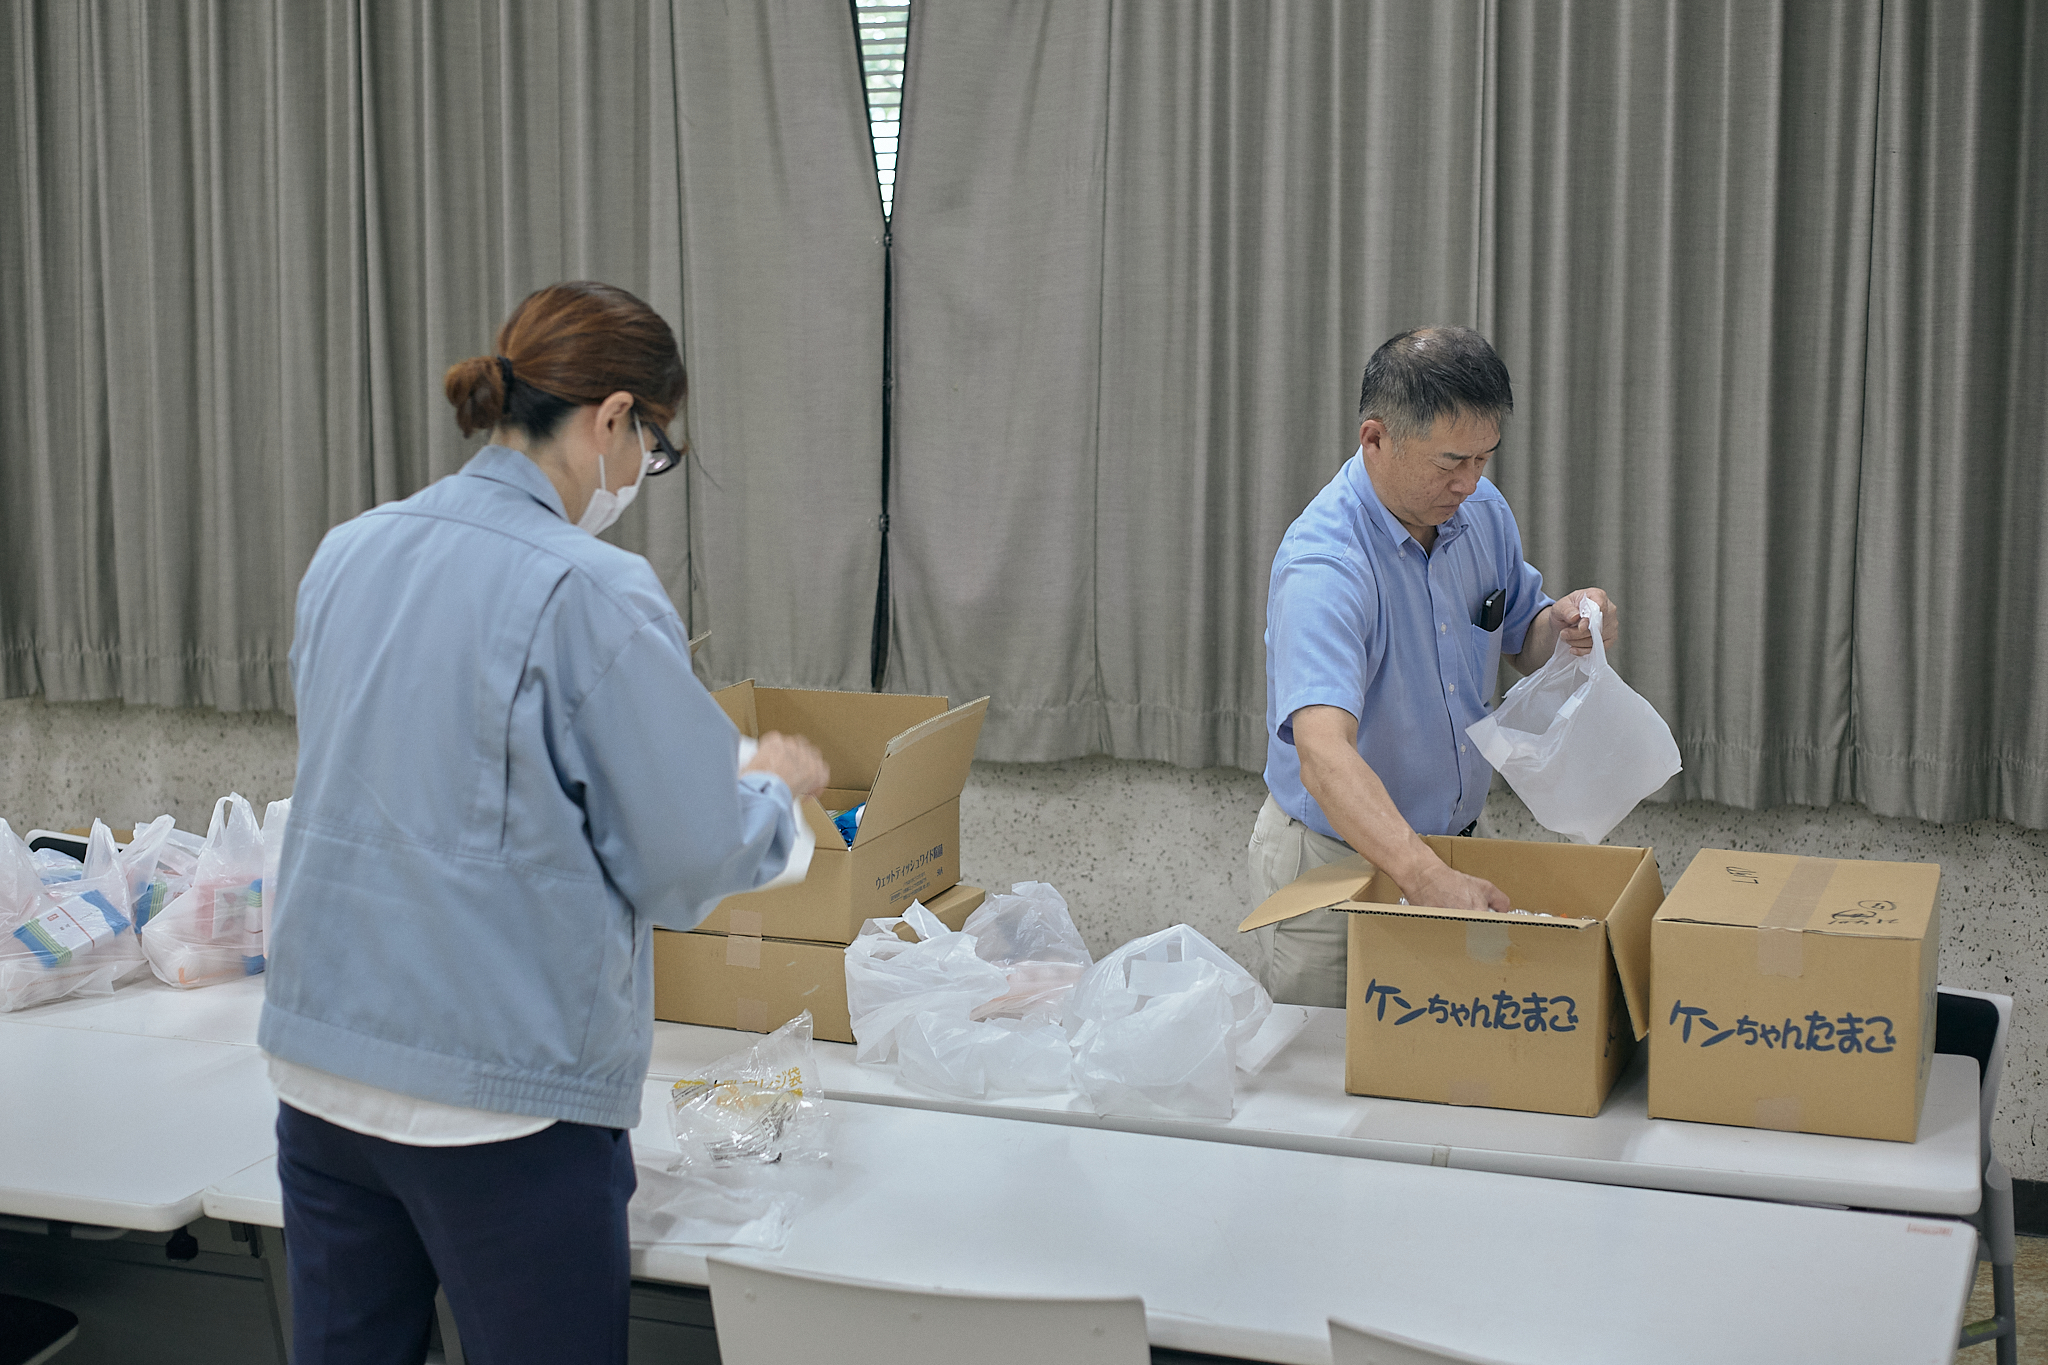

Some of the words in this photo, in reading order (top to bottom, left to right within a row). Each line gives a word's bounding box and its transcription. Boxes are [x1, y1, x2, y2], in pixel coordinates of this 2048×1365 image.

[1365, 978, 1579, 1032] ケンちゃんたまご
[1669, 999, 1897, 1054] ケンちゃんたまご
